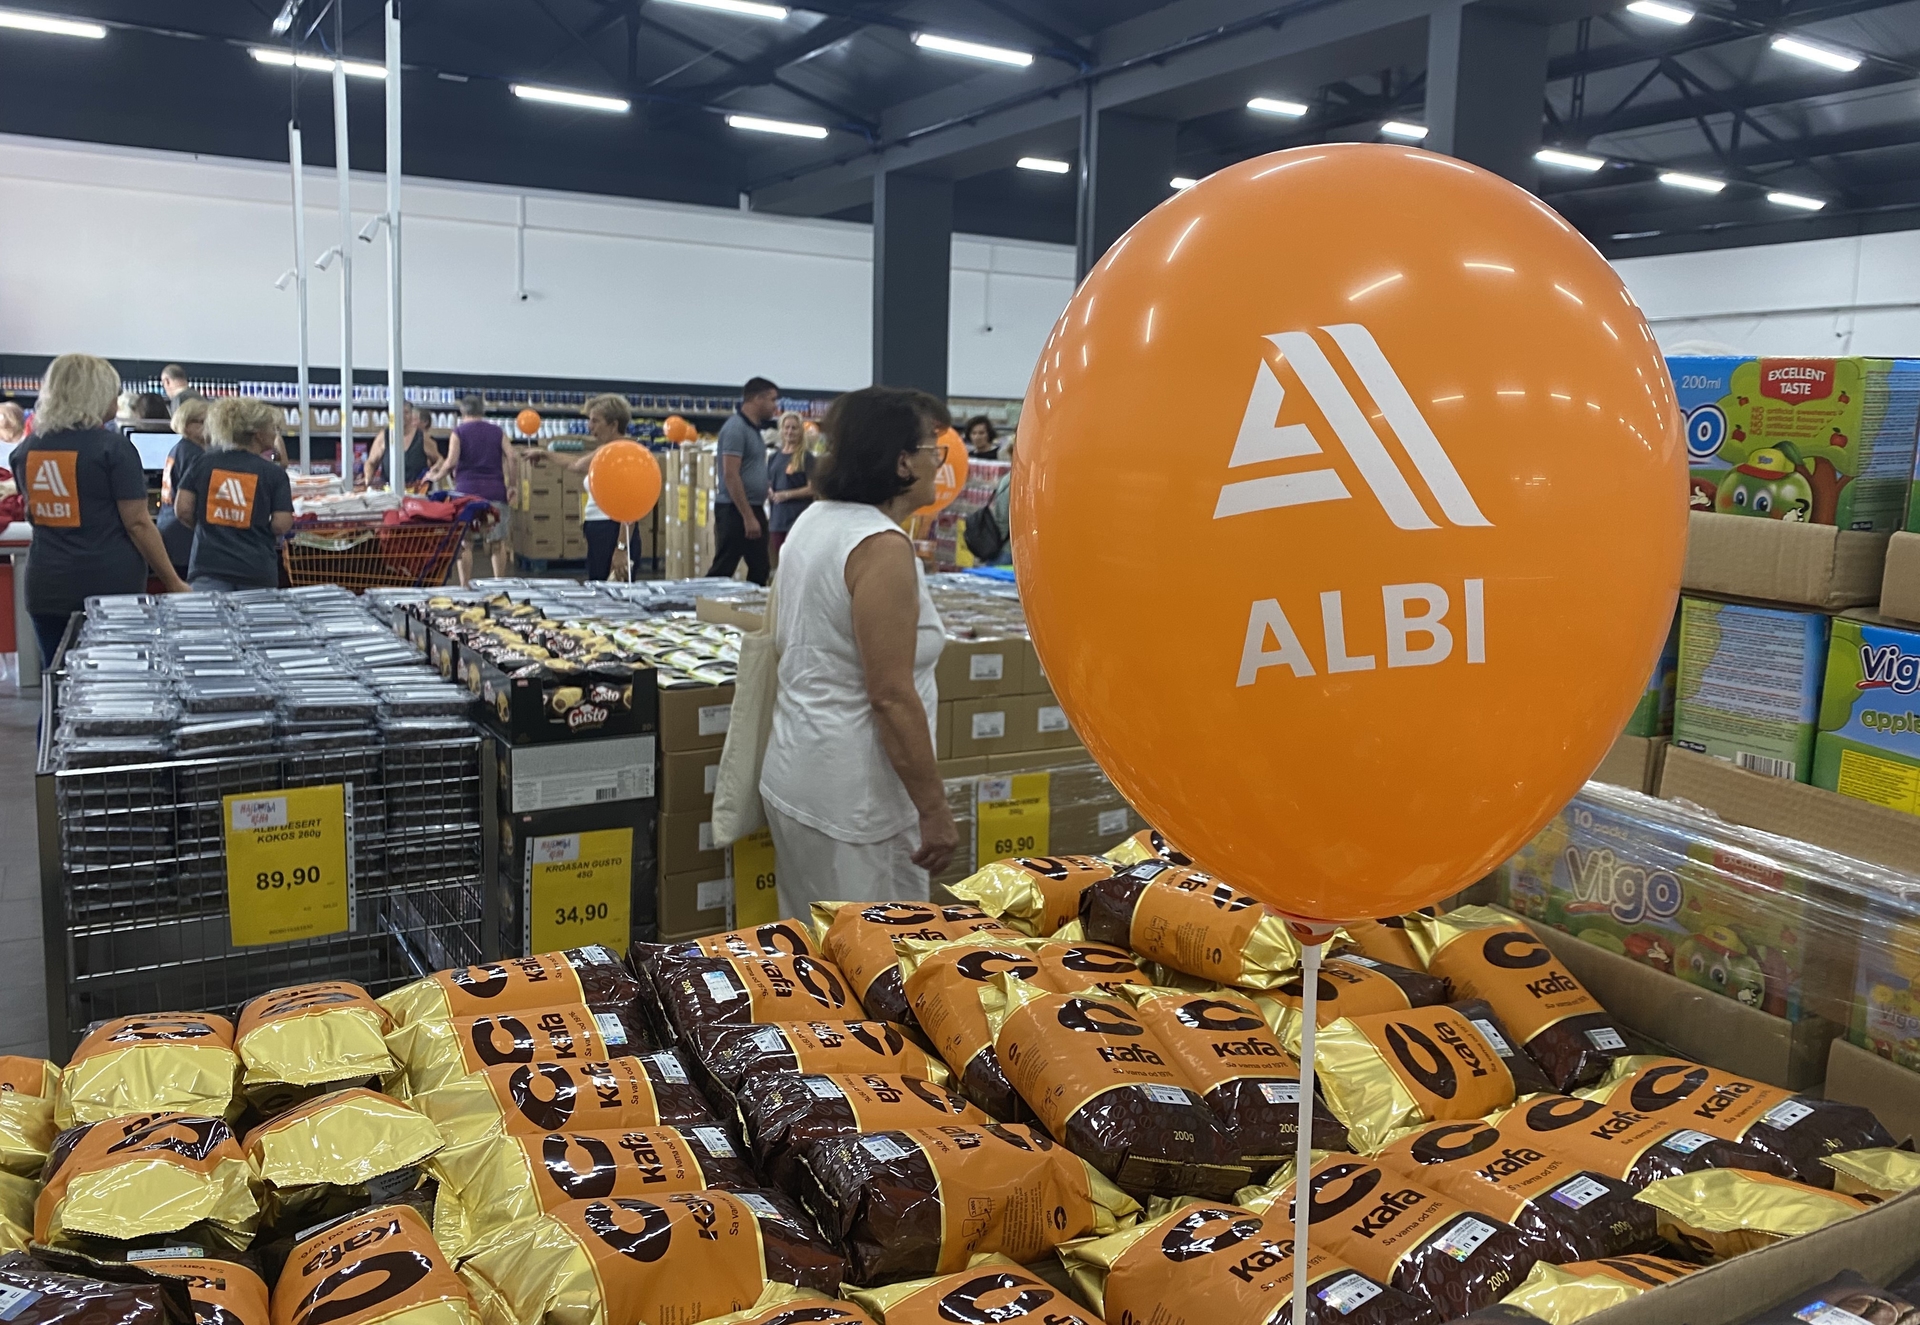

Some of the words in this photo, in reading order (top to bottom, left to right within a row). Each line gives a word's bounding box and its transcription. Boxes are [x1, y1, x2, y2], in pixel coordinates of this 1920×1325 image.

[1681, 375, 1722, 389] 200ml
[1768, 367, 1827, 382] EXCELLENT
[1780, 382, 1812, 395] TASTE
[35, 502, 72, 519] ALBI
[213, 506, 245, 523] ALBI
[1236, 578, 1486, 687] ALBI
[1860, 644, 1920, 695] Vig
[591, 688, 620, 703] Gusto
[568, 705, 608, 727] Gusto
[257, 832, 295, 844] KOKOS
[995, 836, 1035, 855] 69,90
[545, 861, 590, 873] KROASAN
[256, 866, 320, 891] 89,90
[1565, 845, 1683, 926] Vigo
[555, 902, 608, 926] 34,90
[1525, 971, 1579, 999] kafa
[537, 1013, 577, 1059] kafa
[1096, 1043, 1166, 1066] kafa
[1211, 1037, 1282, 1058] kafa
[1433, 1021, 1488, 1078] kafa
[1694, 1082, 1755, 1120] kafa
[1173, 1131, 1195, 1143] 200g
[618, 1131, 667, 1184] kafa
[1475, 1148, 1547, 1183] kafa
[1521, 1174, 1542, 1187] vama
[1352, 1188, 1427, 1239] kafa
[328, 1230, 344, 1241] od
[729, 1223, 739, 1236] Sa
[1382, 1237, 1397, 1247] Sa
[1398, 1221, 1420, 1239] vama
[1417, 1212, 1430, 1223] od
[1609, 1221, 1633, 1235] 200g
[302, 1219, 402, 1277] kafa
[1275, 1270, 1295, 1284] vam
